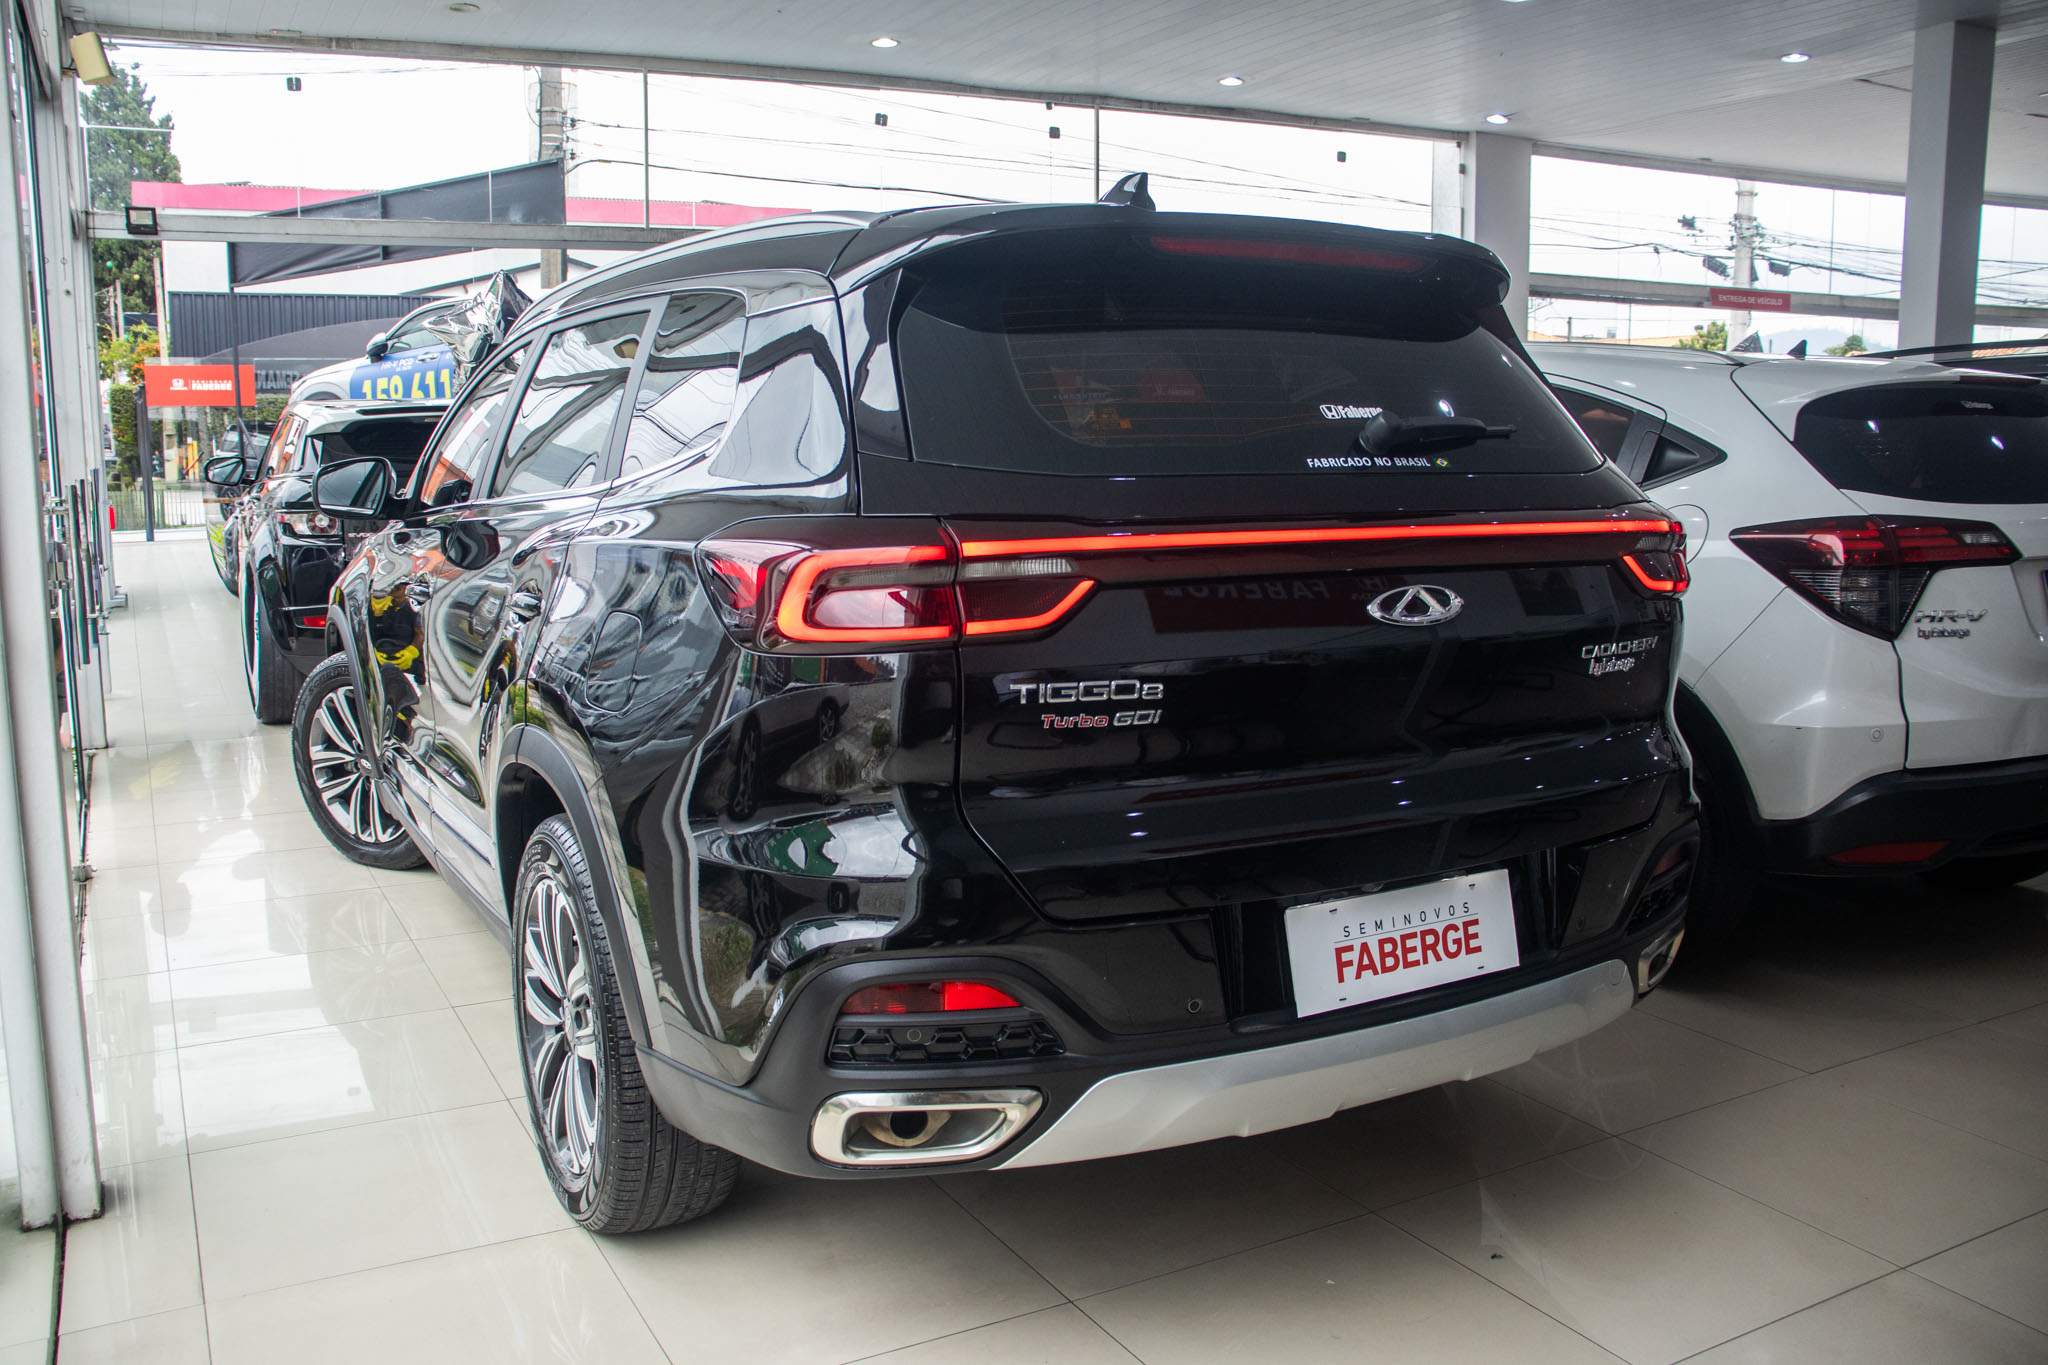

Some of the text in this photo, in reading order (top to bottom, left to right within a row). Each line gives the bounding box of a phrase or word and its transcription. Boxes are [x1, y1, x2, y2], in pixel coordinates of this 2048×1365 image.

[1719, 295, 1747, 303] ENTREGA
[1306, 457, 1431, 468] FABRICADO NO BRASIL
[1914, 608, 1988, 622] HR-V
[1041, 713, 1109, 728] Turbo
[1343, 901, 1470, 938] SEMINOVOS
[1334, 918, 1482, 984] FABERGE
